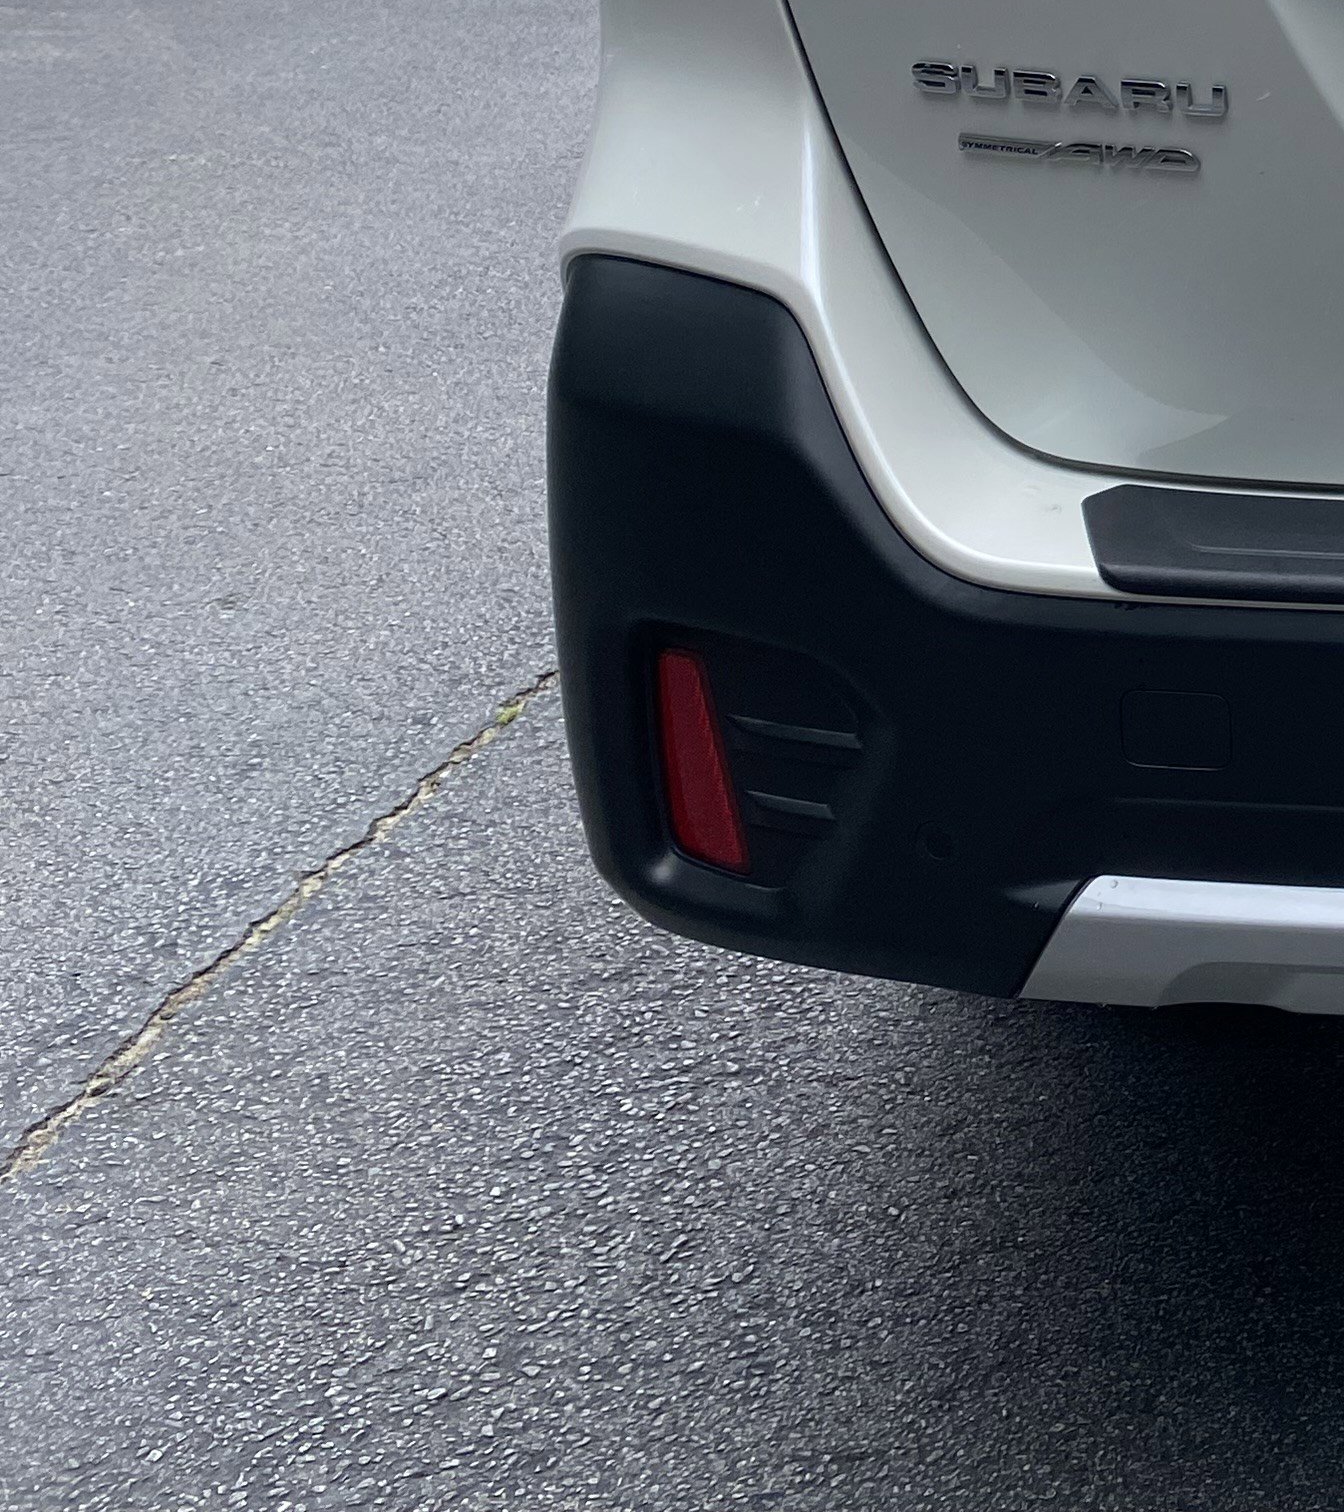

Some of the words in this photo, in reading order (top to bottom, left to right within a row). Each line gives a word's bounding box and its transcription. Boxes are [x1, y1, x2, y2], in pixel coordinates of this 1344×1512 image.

[911, 60, 1229, 116] SUBARU
[961, 141, 1039, 156] SYMMETRICAL
[1051, 142, 1201, 172] AWD
